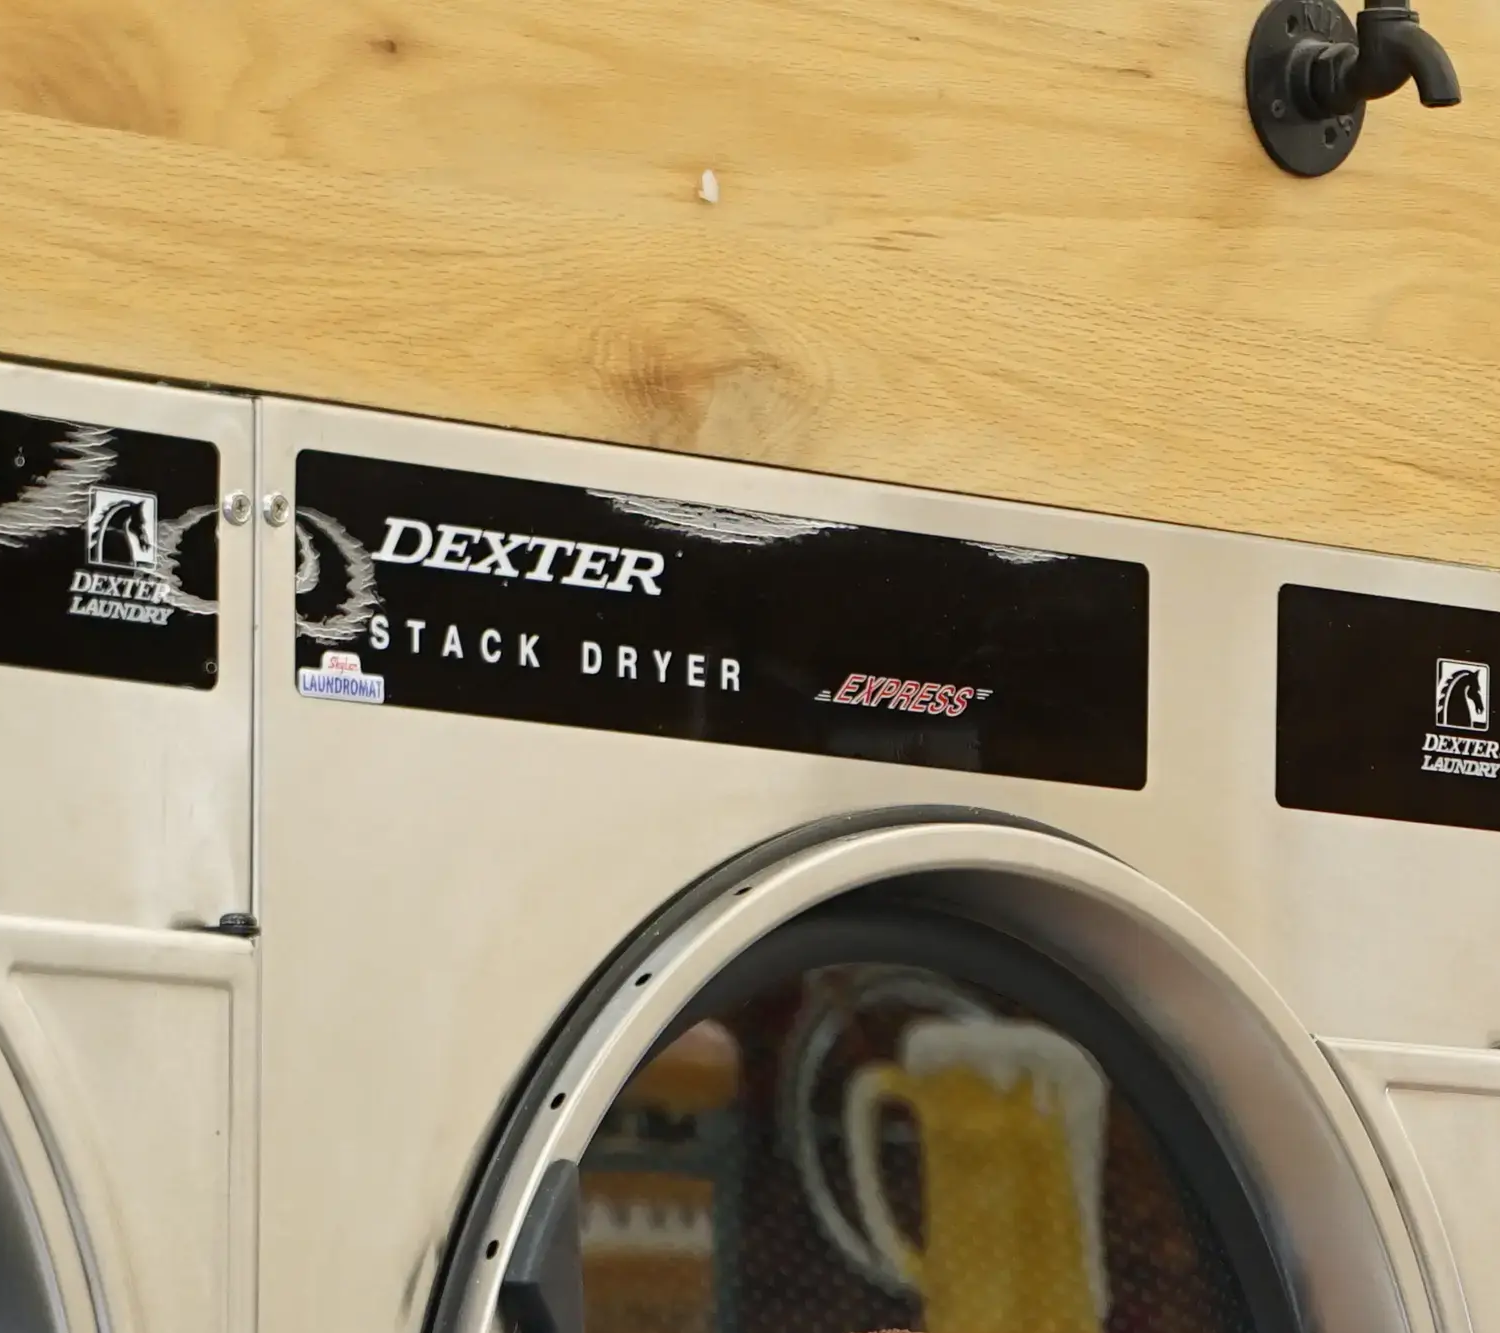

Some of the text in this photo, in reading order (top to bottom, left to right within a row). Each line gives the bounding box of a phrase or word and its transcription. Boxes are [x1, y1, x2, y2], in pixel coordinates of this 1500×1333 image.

[371, 517, 665, 595] DEXTER
[70, 571, 172, 604] DEXTER
[69, 597, 174, 625] LAUNDRY
[369, 614, 741, 692] STACK DRYER
[303, 674, 382, 698] LAUNDROMAT
[833, 673, 975, 717] EXPRESS
[1422, 733, 1500, 759] DEXTER
